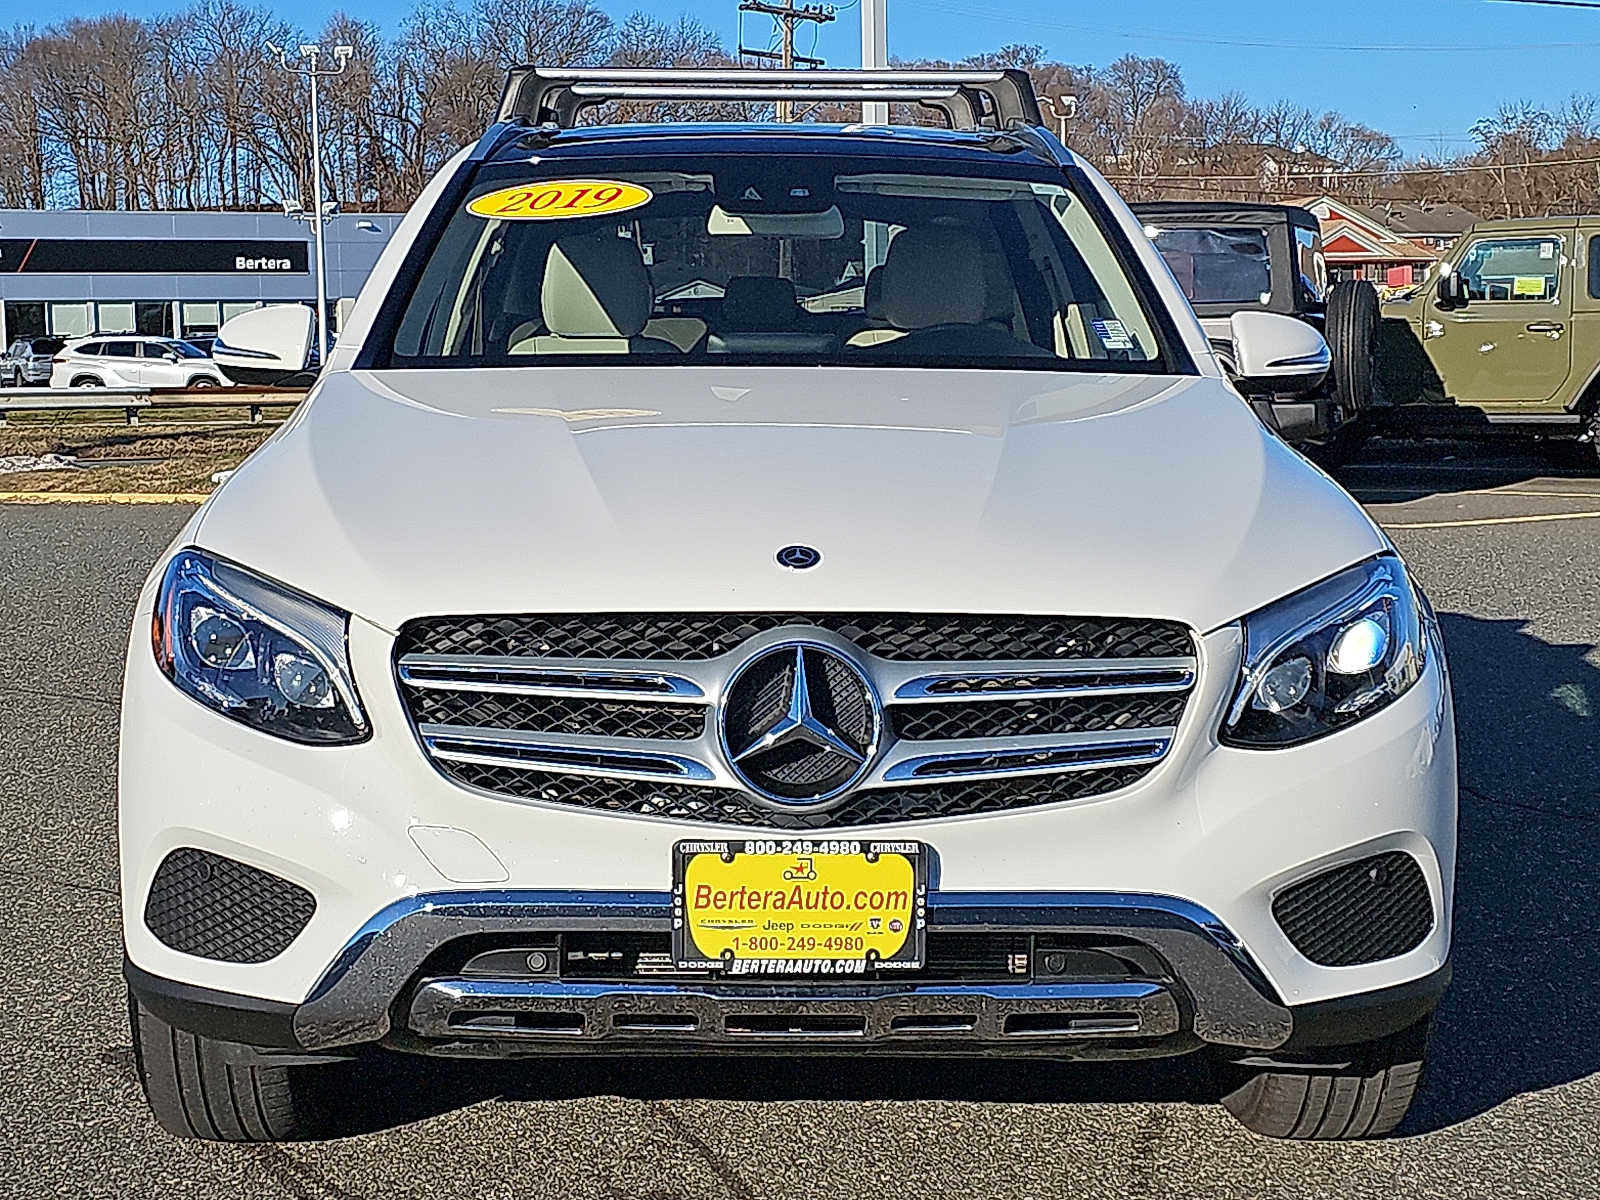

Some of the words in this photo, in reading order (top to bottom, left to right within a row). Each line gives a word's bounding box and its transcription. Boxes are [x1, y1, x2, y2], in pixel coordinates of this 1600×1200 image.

[496, 187, 623, 213] 2019
[235, 256, 291, 270] Bertera
[679, 842, 729, 853] CHRYSLER
[870, 842, 920, 853] CHRYSLER
[694, 884, 908, 911] BerteraAuto.com
[762, 919, 795, 933] Jeep
[732, 936, 864, 951] 1-800-249-4980
[678, 961, 724, 969] DODGE
[731, 959, 867, 974] BERTERAAUTO.COM
[874, 961, 920, 969] DODGE
